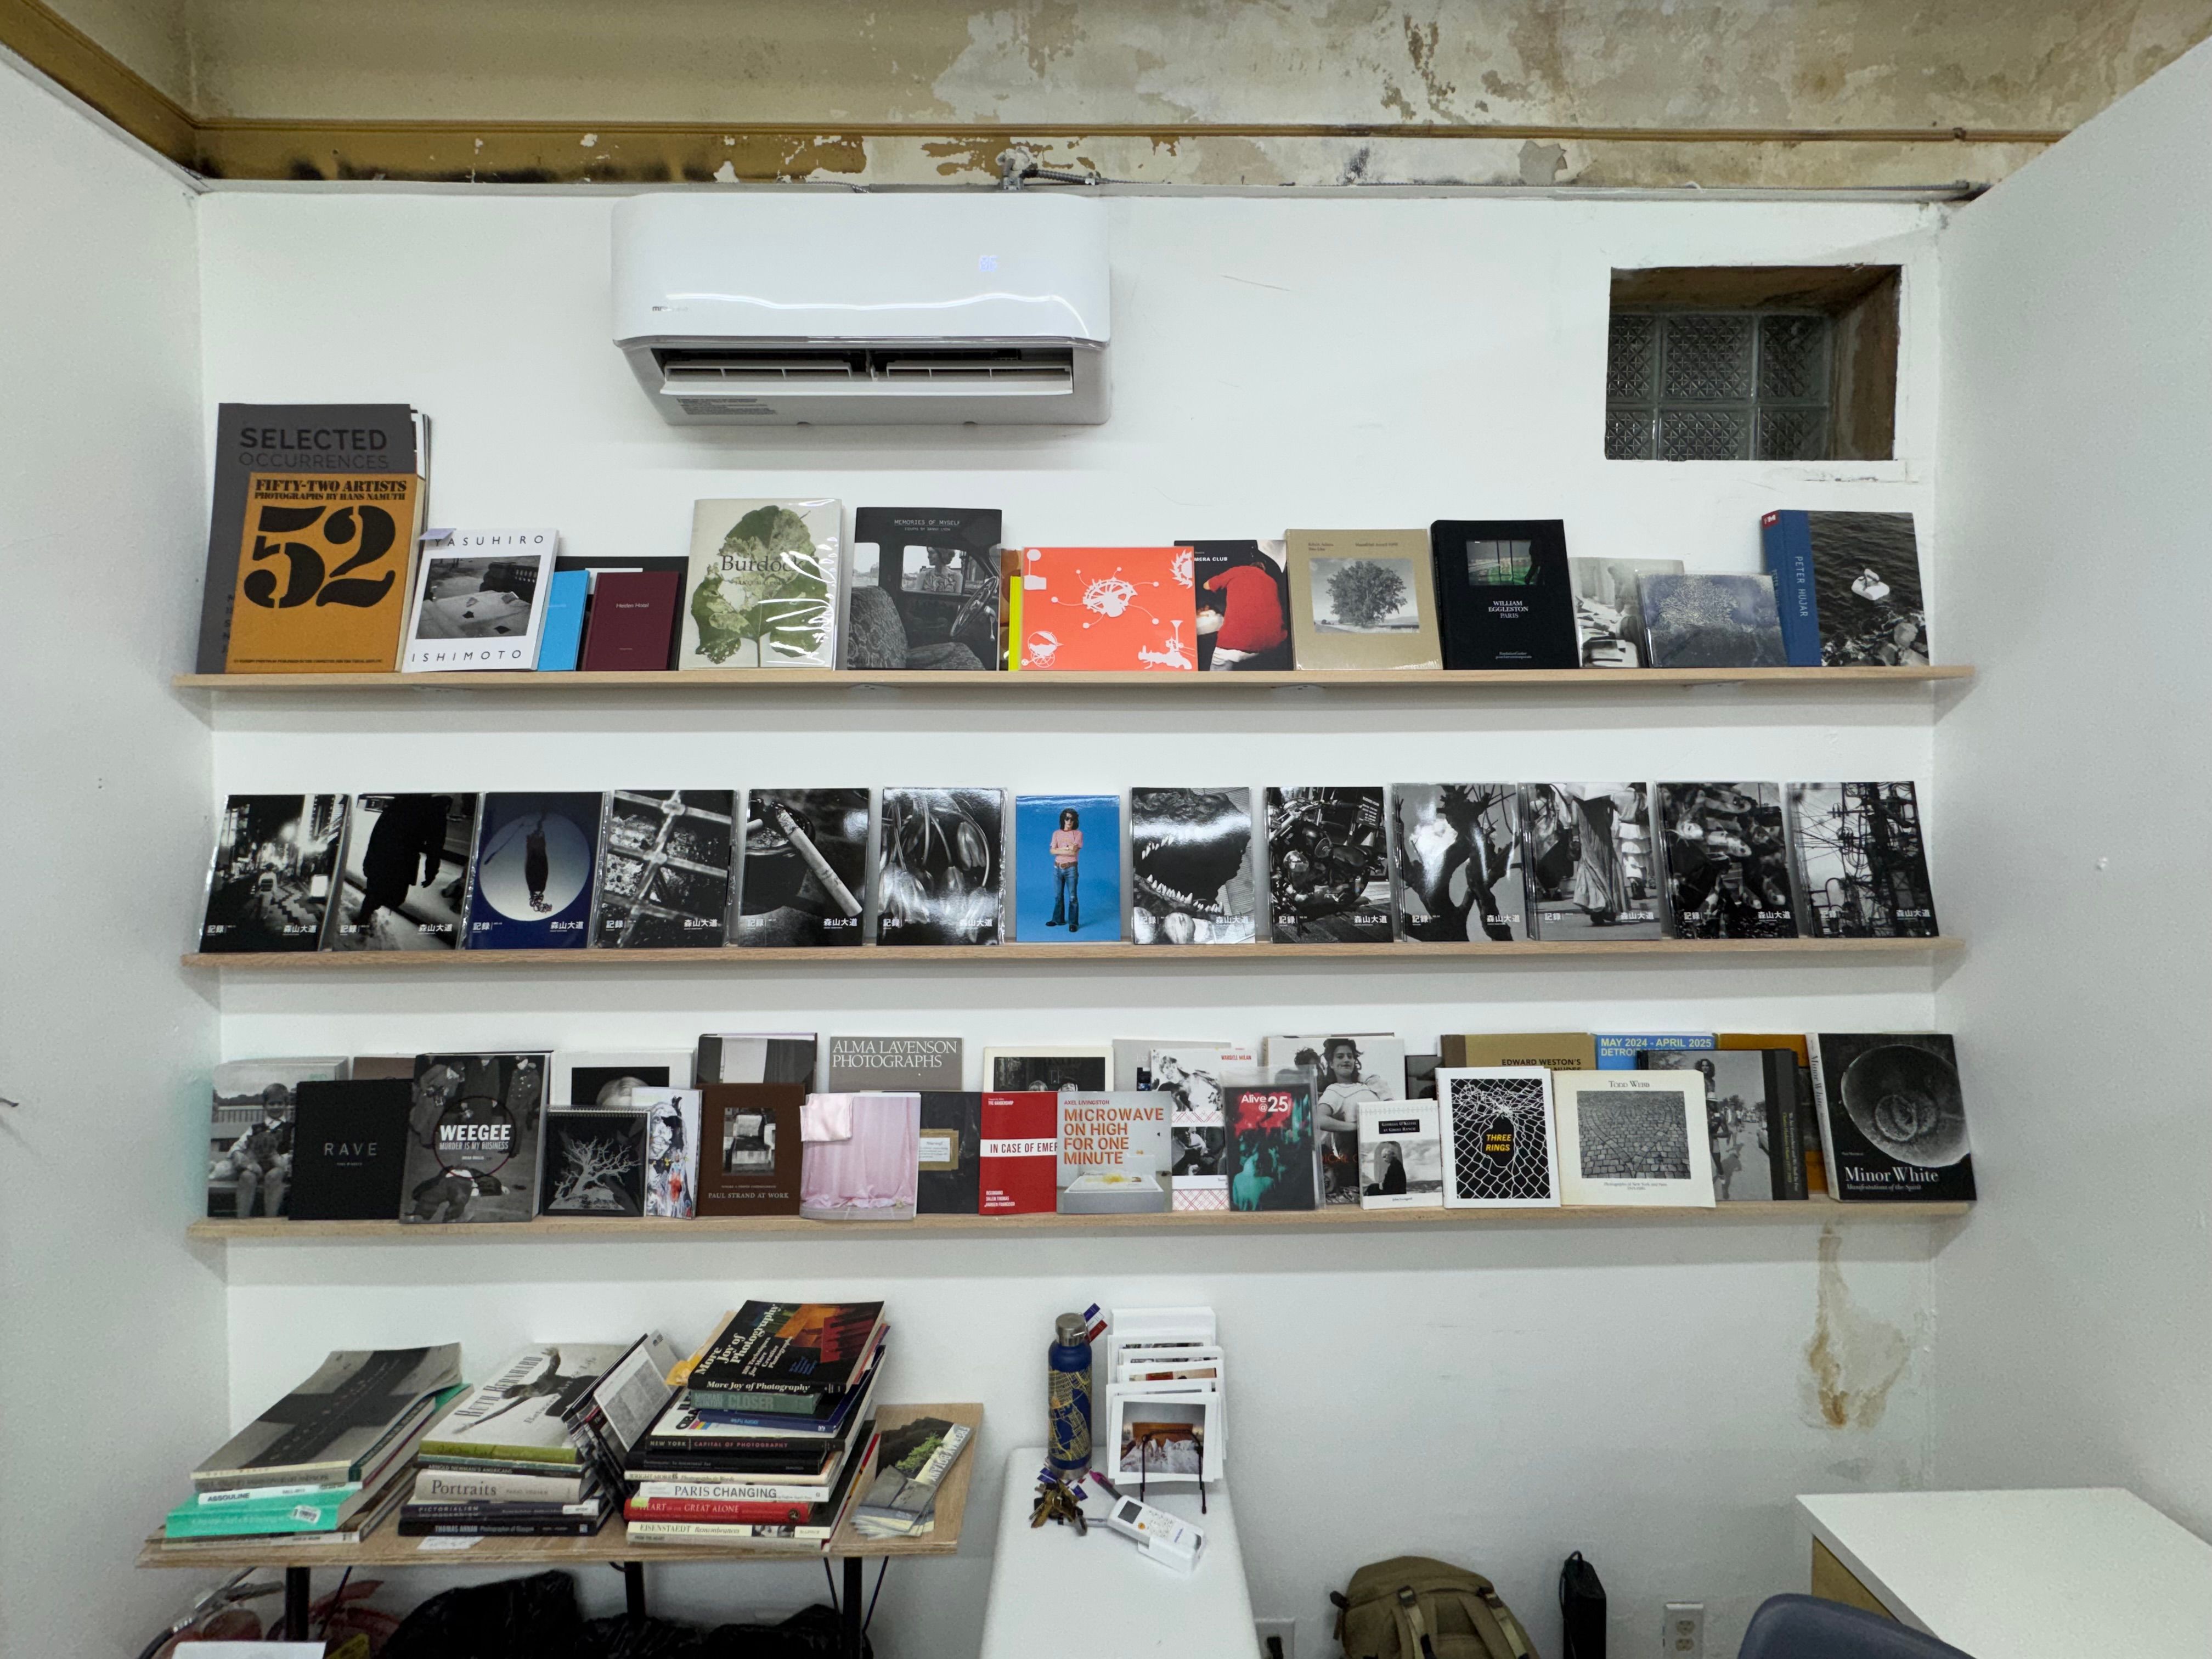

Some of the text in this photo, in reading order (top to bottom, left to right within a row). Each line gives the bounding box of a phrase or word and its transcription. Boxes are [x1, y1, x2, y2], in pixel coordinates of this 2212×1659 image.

[240, 428, 387, 450] SELECTED
[238, 452, 389, 469] OCCURRENCES
[256, 479, 407, 492] FIFTY-TWO ARTISTS
[255, 492, 324, 500] PHOTOGRAPHS
[435, 535, 544, 547] YASUHIRO
[244, 505, 396, 608] 52
[721, 555, 804, 572] Burdock
[1795, 556, 1809, 617] PETER HUJAR
[411, 650, 522, 663] ISHIMOTO
[1138, 916, 1156, 924] 記録
[1216, 916, 1249, 924] 森山大道
[1279, 916, 1295, 924] 記録
[1354, 916, 1387, 924] 森山大道
[1412, 915, 1428, 923] 記録
[1487, 915, 1520, 923] 森山大道
[1821, 910, 1837, 918] 記録
[283, 924, 317, 933] 森山大道
[418, 924, 453, 932] 森山大道
[606, 920, 623, 928] 記録
[684, 919, 718, 927] 森山大道
[747, 918, 764, 927] 記録
[883, 918, 900, 927] 記録
[959, 918, 992, 927] 森山大道
[207, 925, 224, 933] 記録
[340, 925, 357, 933] 記録
[832, 1040, 957, 1054] ALMA LAVENSON
[1600, 1038, 1622, 1046] MAY
[1625, 1039, 1647, 1047] 2024
[1656, 1039, 1686, 1047] APRIL
[1689, 1039, 1712, 1047] 2025
[1600, 1048, 1638, 1057] DETROI
[832, 1055, 943, 1068] PHOTOGRAPHS
[1810, 1055, 1819, 1082] Minor
[1241, 1094, 1266, 1104] Alive
[1259, 1096, 1288, 1113] @ 25
[1064, 1108, 1164, 1121] MICROWAVE
[439, 1124, 512, 1141] WEEGEE
[1064, 1122, 1128, 1136] ON HIGH
[324, 1143, 378, 1156] RAVE
[439, 1142, 509, 1150] MURDER IS MY BUSINESS
[990, 1144, 998, 1153] IN
[1001, 1143, 1022, 1154] CASE
[1025, 1143, 1035, 1153] OF
[1064, 1137, 1129, 1150] FOR ONE
[1064, 1152, 1124, 1165] MINUTE
[1844, 1166, 1939, 1182] Minor White
[730, 1304, 782, 1364] Photography
[694, 1333, 746, 1375] More Joy of
[454, 1356, 544, 1417] RUTH BERNHARD
[729, 1381, 744, 1390] Joy
[746, 1382, 757, 1391] of
[756, 1383, 810, 1393] Photography
[729, 1394, 773, 1410] CLOSER
[524, 1395, 558, 1424] Between
[929, 1454, 952, 1483] BOTANY
[431, 1480, 496, 1496] Portraits
[674, 1486, 777, 1498] PARIS CHANGING
[207, 1492, 250, 1502] ASSOULINE
[684, 1504, 710, 1512] GREAT
[712, 1504, 739, 1513] ALONE
[640, 1523, 740, 1534] EISENSTAEDT Remembrances
